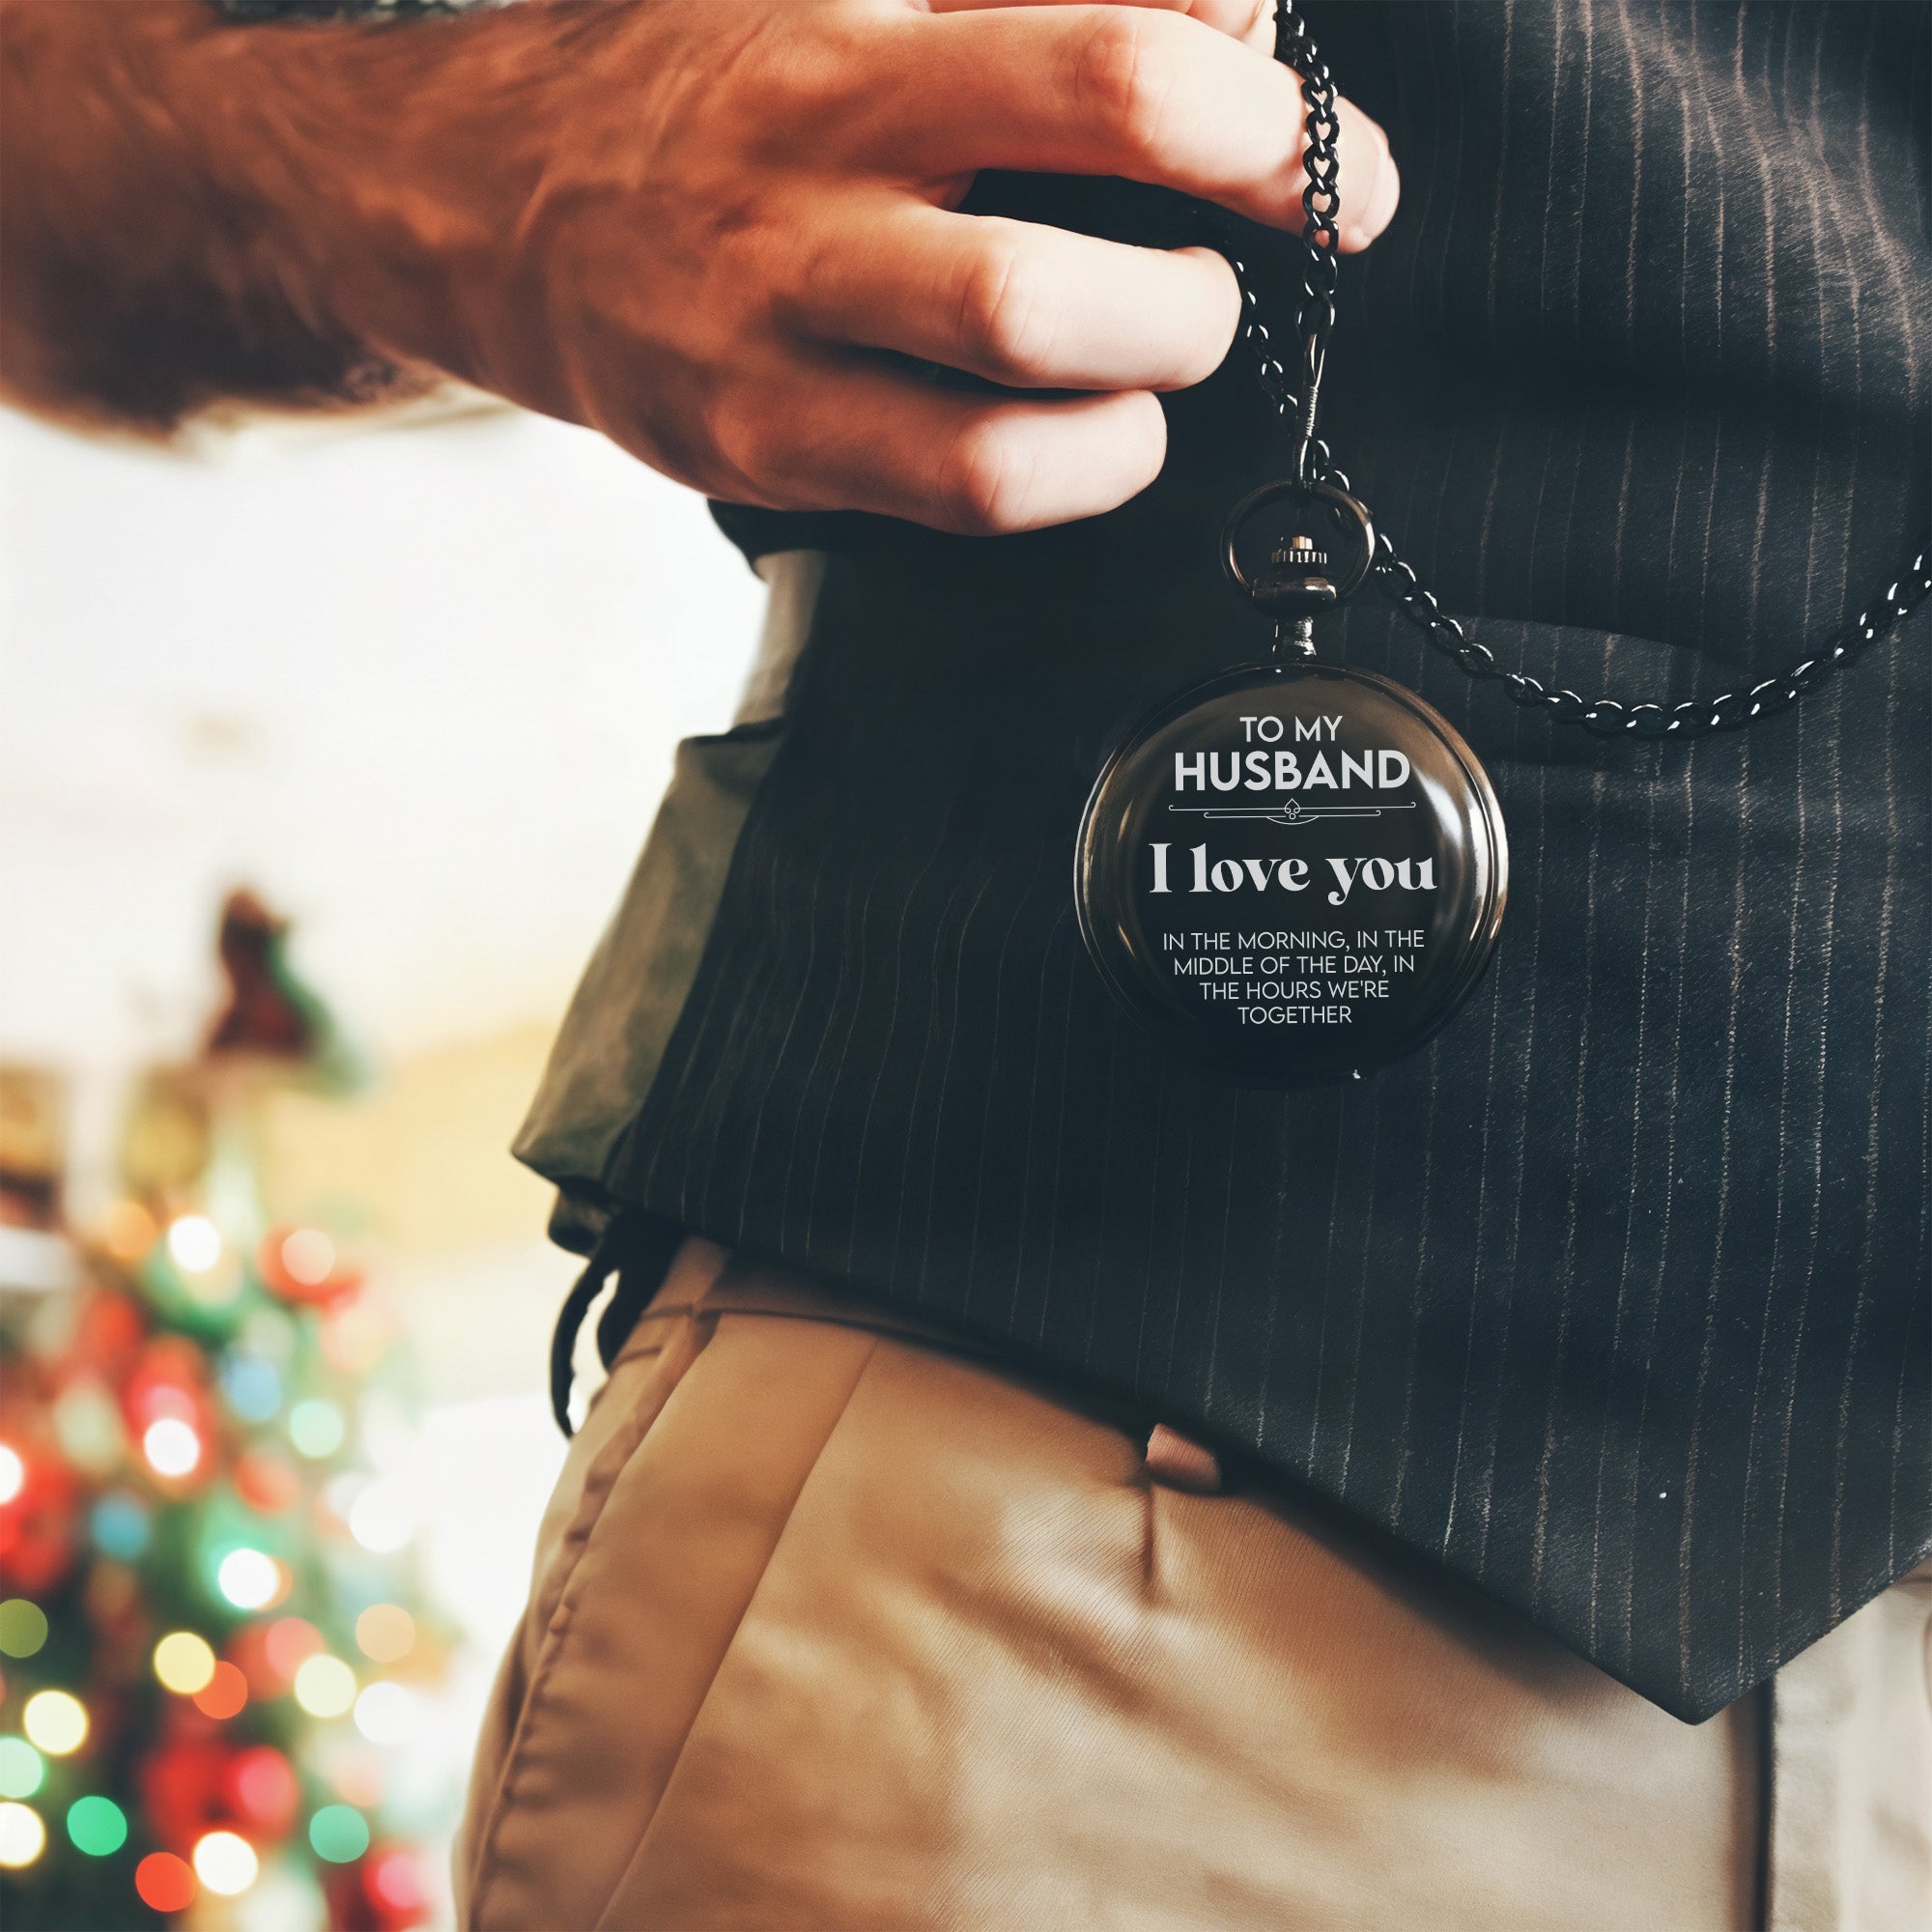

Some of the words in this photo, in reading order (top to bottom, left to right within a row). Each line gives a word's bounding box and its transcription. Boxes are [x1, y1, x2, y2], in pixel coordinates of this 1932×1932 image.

[1239, 716, 1283, 742] TO
[1295, 716, 1343, 742] MY
[1175, 750, 1410, 791] HUSBAND
[1149, 842, 1172, 894] I
[1189, 842, 1311, 893] love
[1324, 857, 1437, 906] you
[1163, 933, 1184, 951] IN
[1191, 932, 1231, 950] THE
[1238, 931, 1350, 952] MORNING,
[1357, 931, 1378, 949] IN
[1384, 930, 1425, 948] THE
[1174, 956, 1254, 976] MIDDLE
[1261, 956, 1291, 975] OF
[1296, 956, 1337, 974] THE
[1344, 955, 1386, 977] DAY,
[1394, 955, 1414, 973] IN
[1199, 982, 1239, 1000] THE
[1246, 981, 1321, 1000] HOURS
[1327, 980, 1389, 999] WE'RE
[1236, 1006, 1352, 1025] TOGETHER
